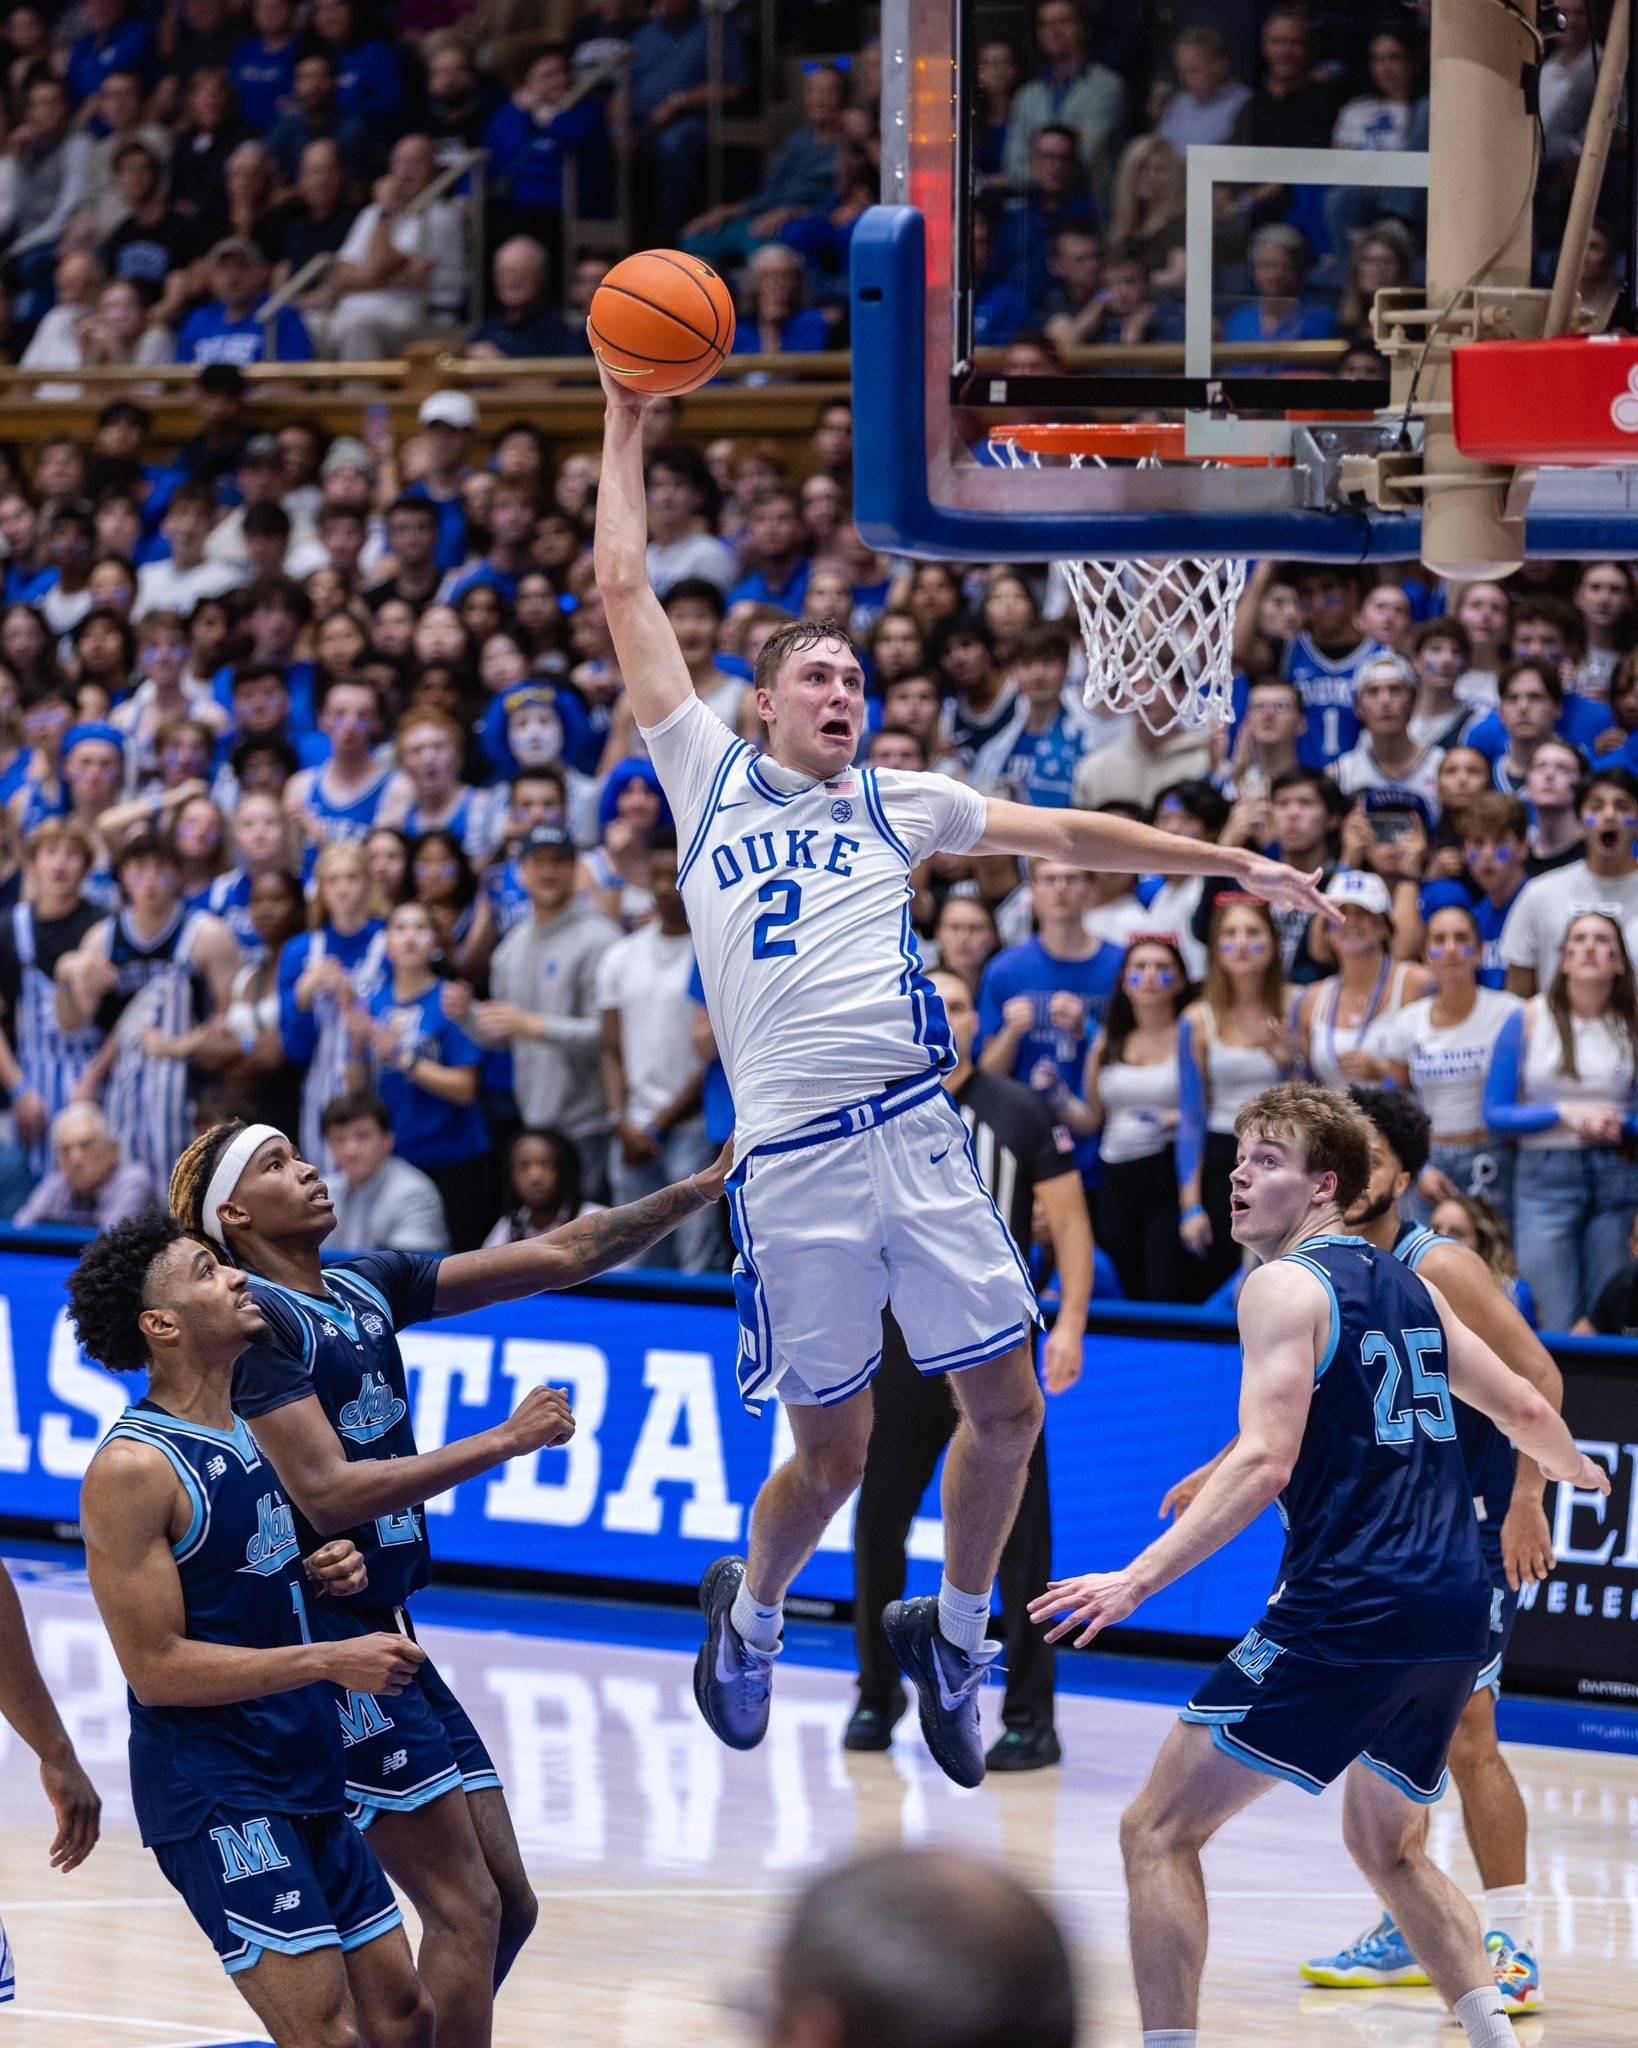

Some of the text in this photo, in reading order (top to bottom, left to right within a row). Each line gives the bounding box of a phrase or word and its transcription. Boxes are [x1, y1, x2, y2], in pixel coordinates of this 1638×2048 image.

[711, 829, 860, 890] DUKE
[753, 879, 802, 960] 2
[1360, 1327, 1457, 1445] 25
[1228, 1627, 1288, 1685] M
[209, 1817, 291, 1883] M
